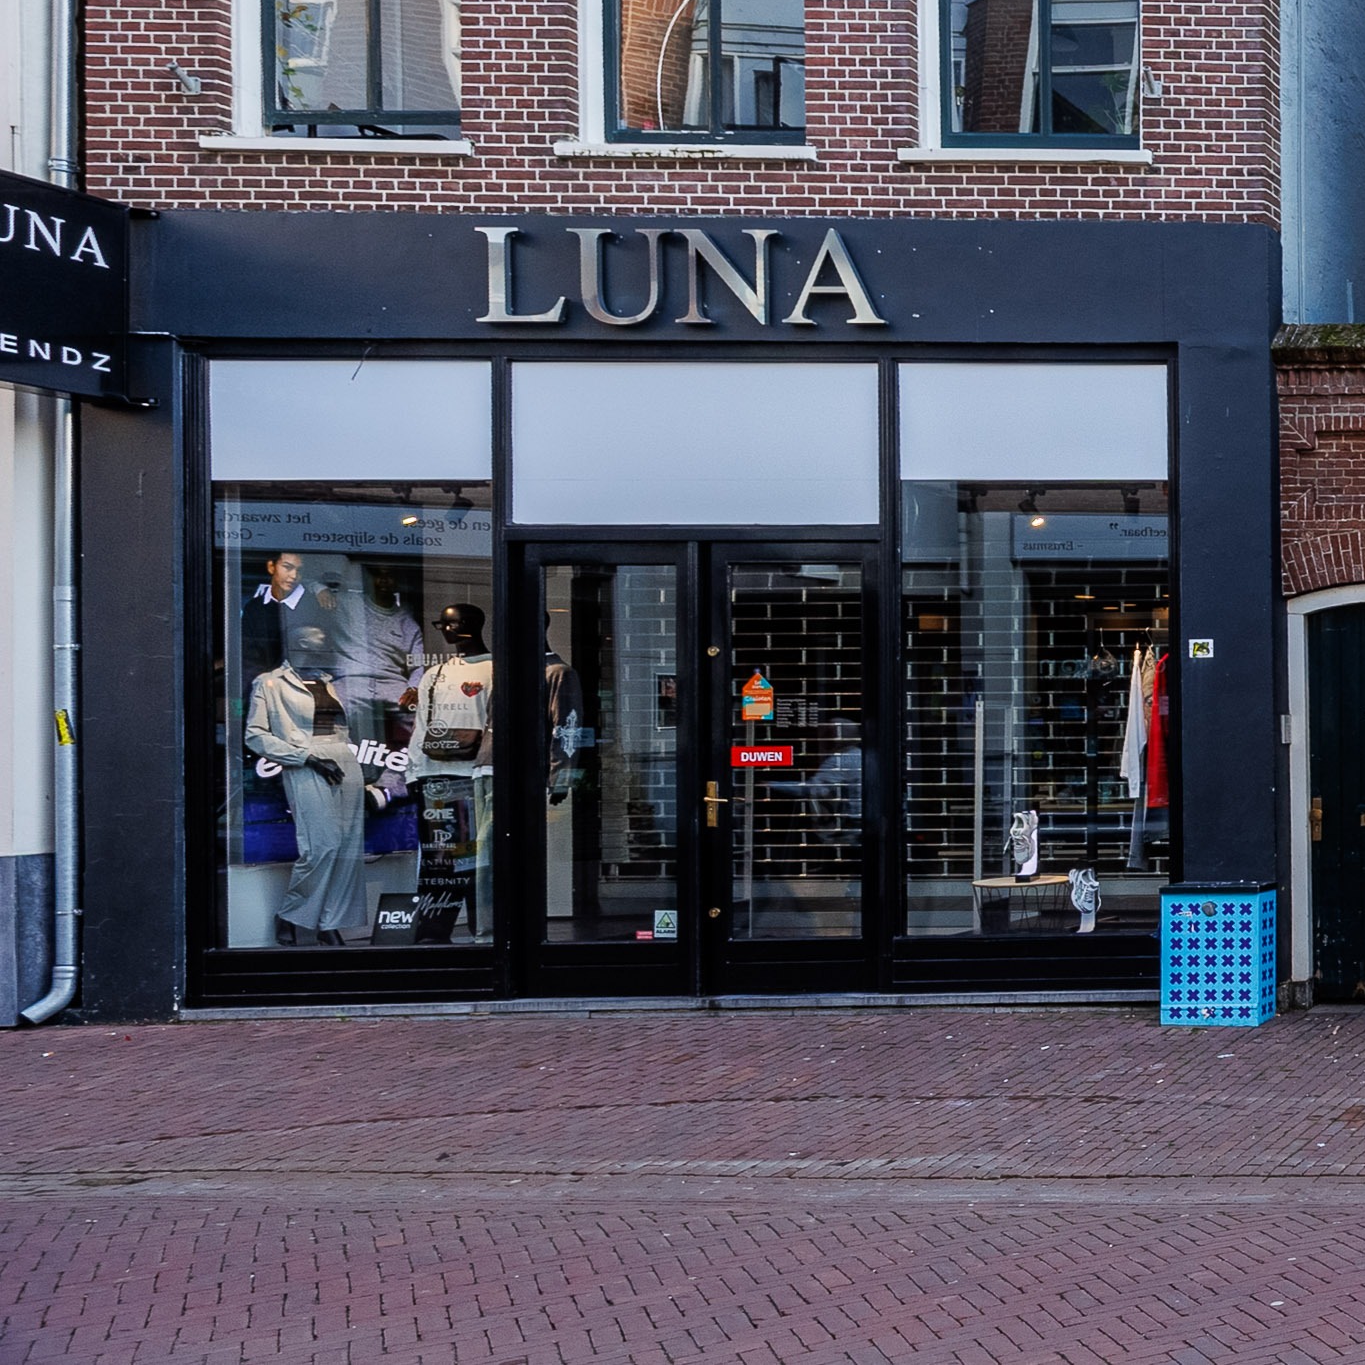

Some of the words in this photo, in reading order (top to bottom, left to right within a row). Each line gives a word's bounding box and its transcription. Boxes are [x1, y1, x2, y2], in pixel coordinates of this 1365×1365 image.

[474, 226, 888, 326] LUNA
[0, 333, 111, 372] ENDZ
[740, 751, 783, 762] DUWEN
[378, 910, 415, 924] new
